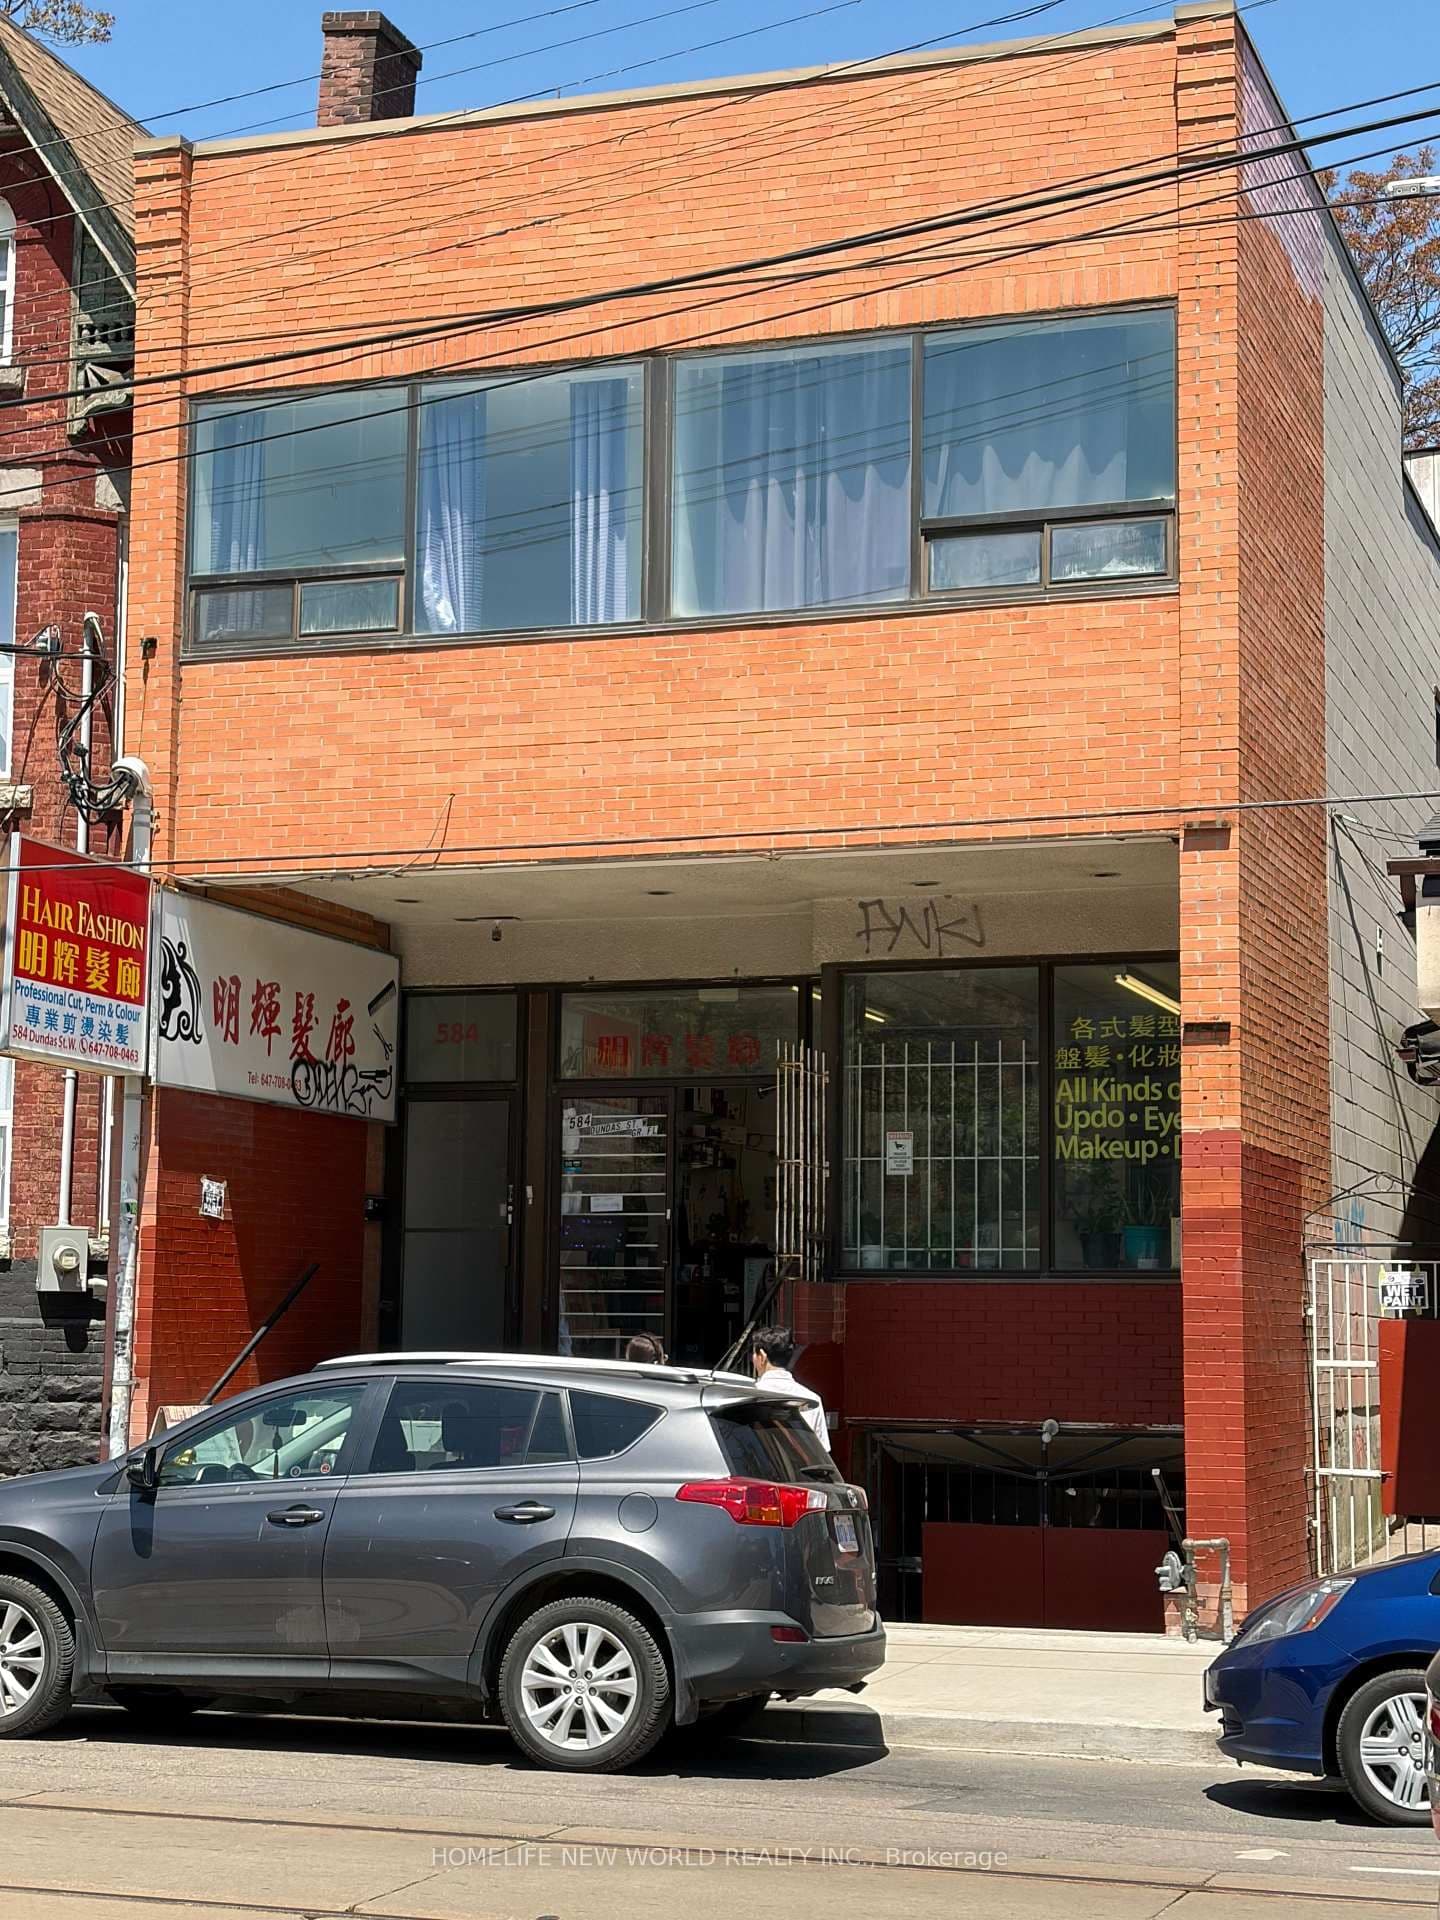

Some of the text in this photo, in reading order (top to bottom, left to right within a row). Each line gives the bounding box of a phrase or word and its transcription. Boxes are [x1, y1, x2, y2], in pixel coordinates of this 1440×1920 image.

[21, 884, 145, 952] HAIR FASHION
[14, 979, 141, 1023] Professional Cut, Perm & Colour
[435, 1023, 478, 1044] 584
[1070, 1015, 1182, 1040] 各式髮型
[12, 1024, 28, 1041] 584
[29, 1029, 57, 1047] Dundas
[88, 1041, 139, 1064] 647-708-0463
[1055, 1076, 1087, 1103] All
[1093, 1075, 1163, 1102] Kinds
[569, 1114, 592, 1129] 584
[591, 1122, 621, 1135] DUNDAS
[1055, 1102, 1125, 1135] Updo
[1055, 1134, 1158, 1165] Makeup
[1383, 1296, 1425, 1307] PAINT
[1386, 1285, 1420, 1297] WET
